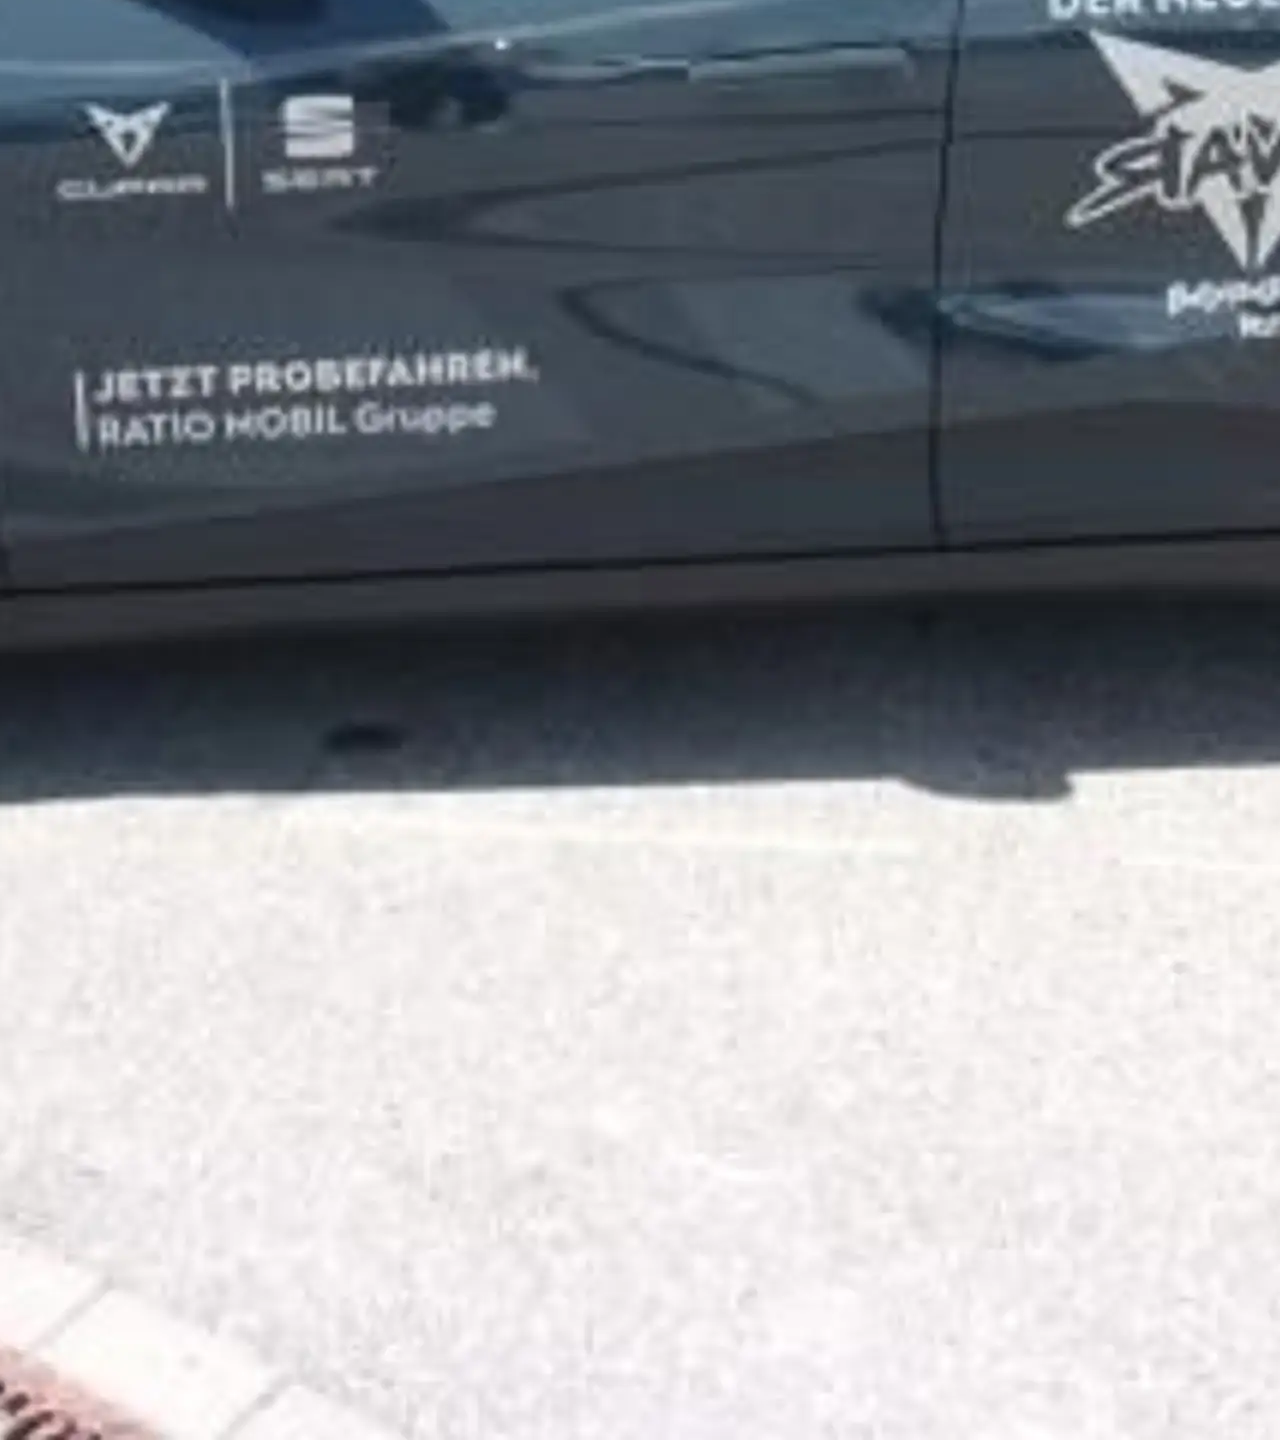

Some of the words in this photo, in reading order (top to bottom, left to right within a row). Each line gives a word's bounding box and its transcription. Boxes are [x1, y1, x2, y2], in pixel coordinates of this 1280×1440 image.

[56, 174, 208, 202] CUPRA
[262, 166, 380, 195] SEAT
[94, 365, 218, 403] JETZT
[228, 347, 539, 396] PROBEFAHREN,
[98, 408, 216, 448] RATIO
[224, 403, 348, 441] MOBIL
[354, 400, 498, 436] Gruppe
